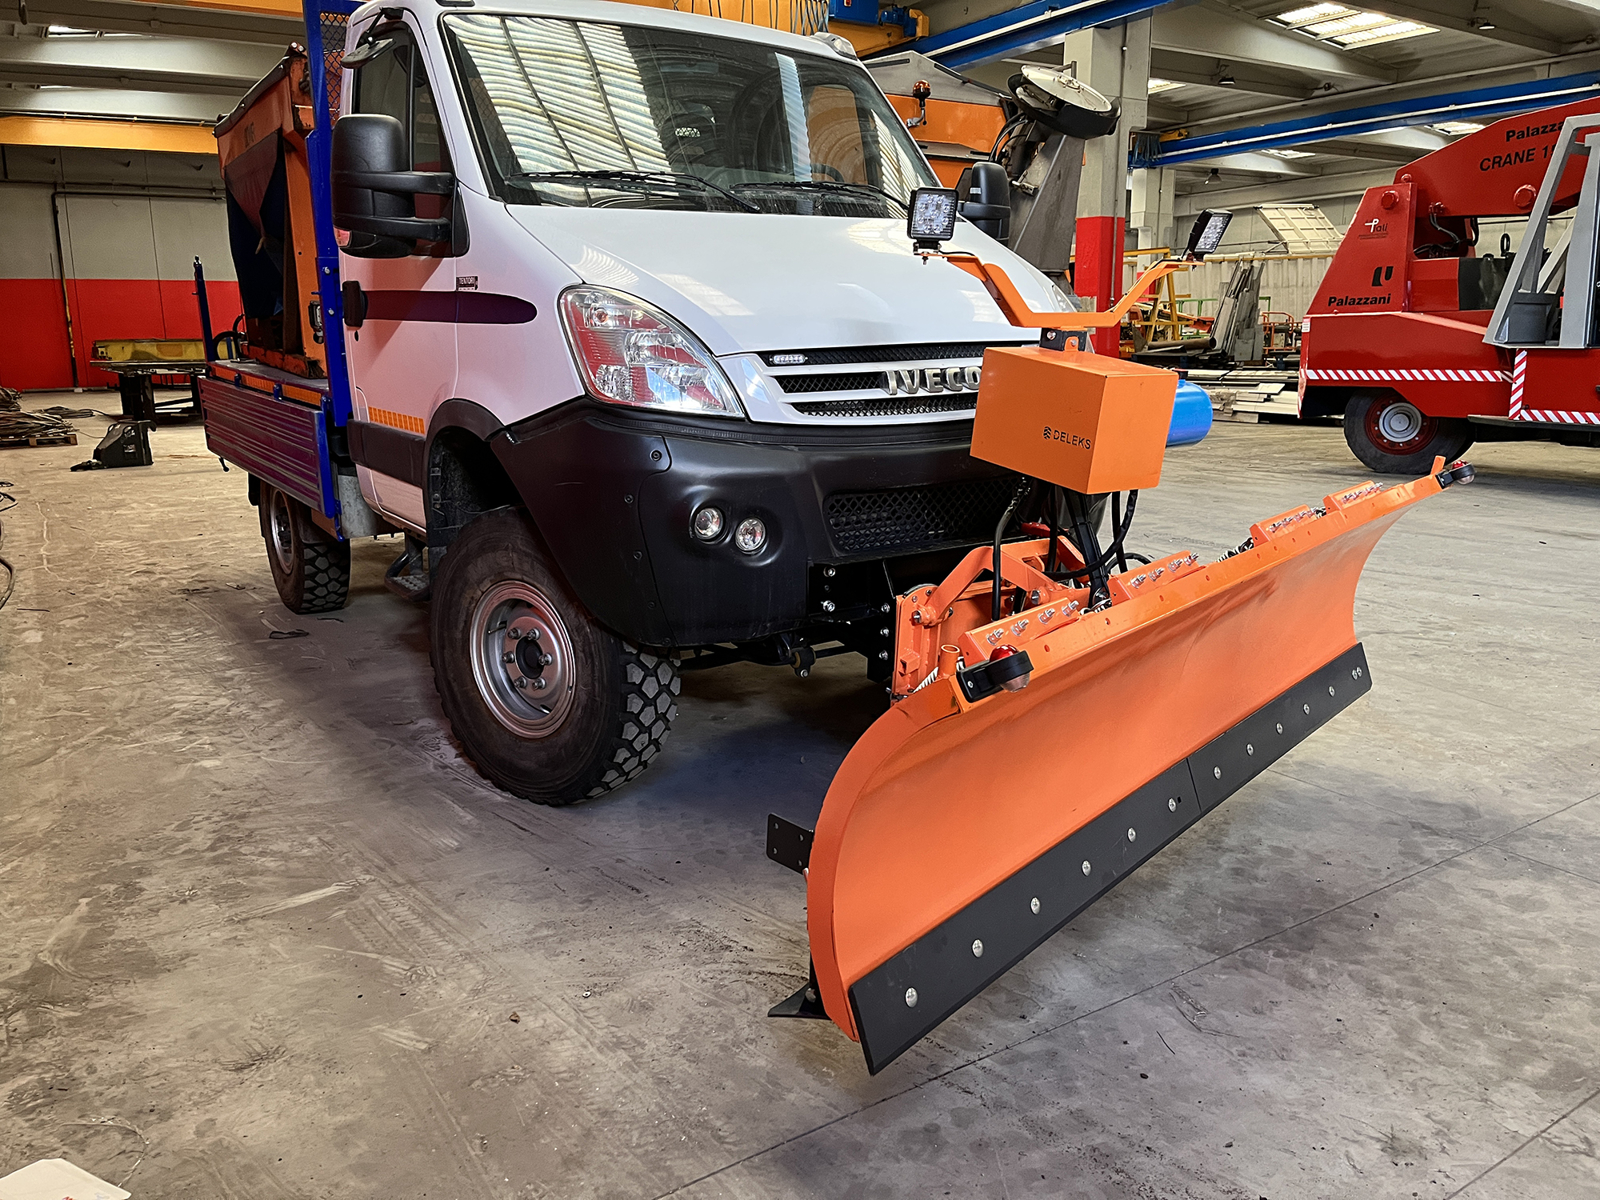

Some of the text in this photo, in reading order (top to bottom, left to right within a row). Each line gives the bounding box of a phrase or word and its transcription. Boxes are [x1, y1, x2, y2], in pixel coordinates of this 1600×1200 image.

[1480, 148, 1536, 171] CRANE
[1328, 293, 1391, 307] Palazzani
[886, 366, 982, 395] IVECO
[1053, 429, 1091, 450] DELEKS
